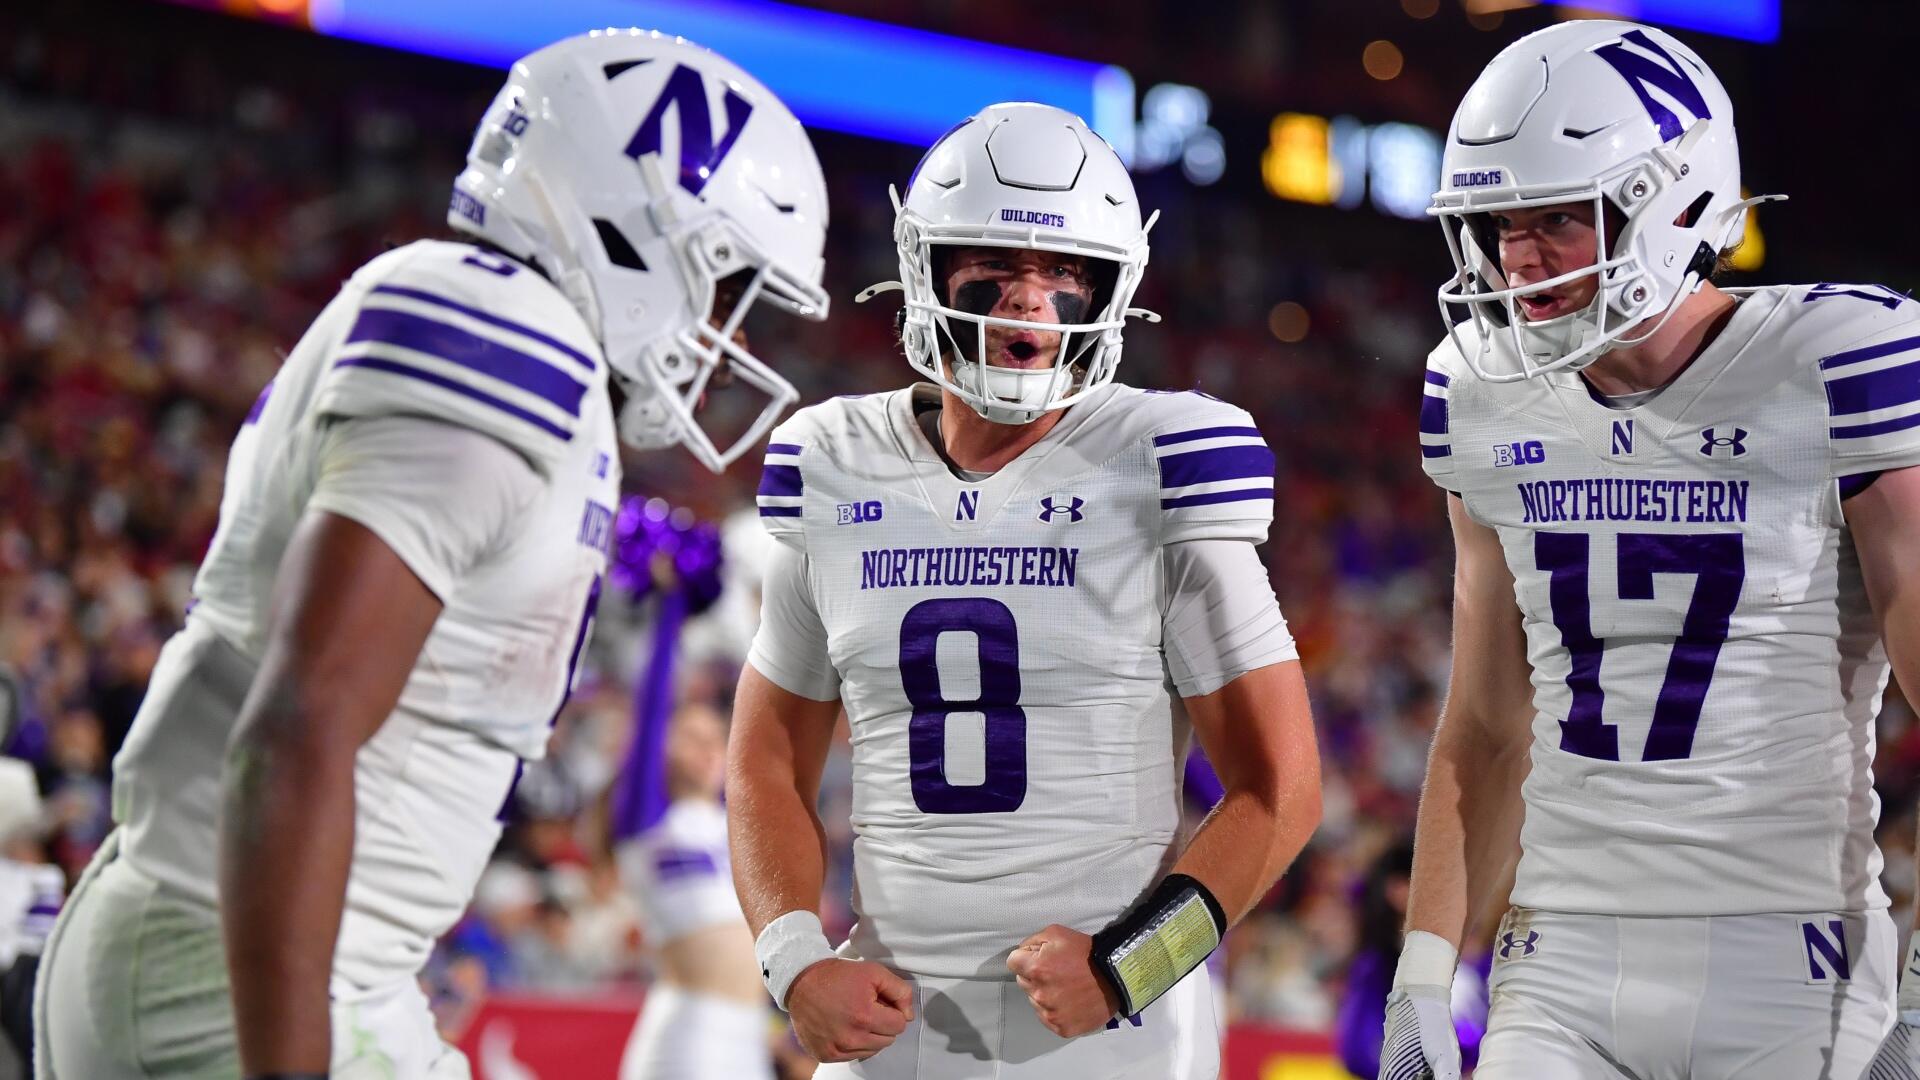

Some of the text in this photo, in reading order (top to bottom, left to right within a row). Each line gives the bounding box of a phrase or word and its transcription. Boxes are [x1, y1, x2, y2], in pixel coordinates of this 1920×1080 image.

[1593, 29, 1712, 143] N
[624, 62, 755, 196] N
[1453, 170, 1501, 187] WILDCATS
[1001, 208, 1064, 227] WILDCATS
[1612, 420, 1633, 455] N
[955, 490, 979, 521] N
[1517, 478, 1749, 523] NORTHWESTERN
[861, 547, 1079, 590] NORTHWESTERN
[1534, 531, 1746, 762] 17
[899, 597, 1027, 814] 8
[1802, 920, 1850, 980] N
